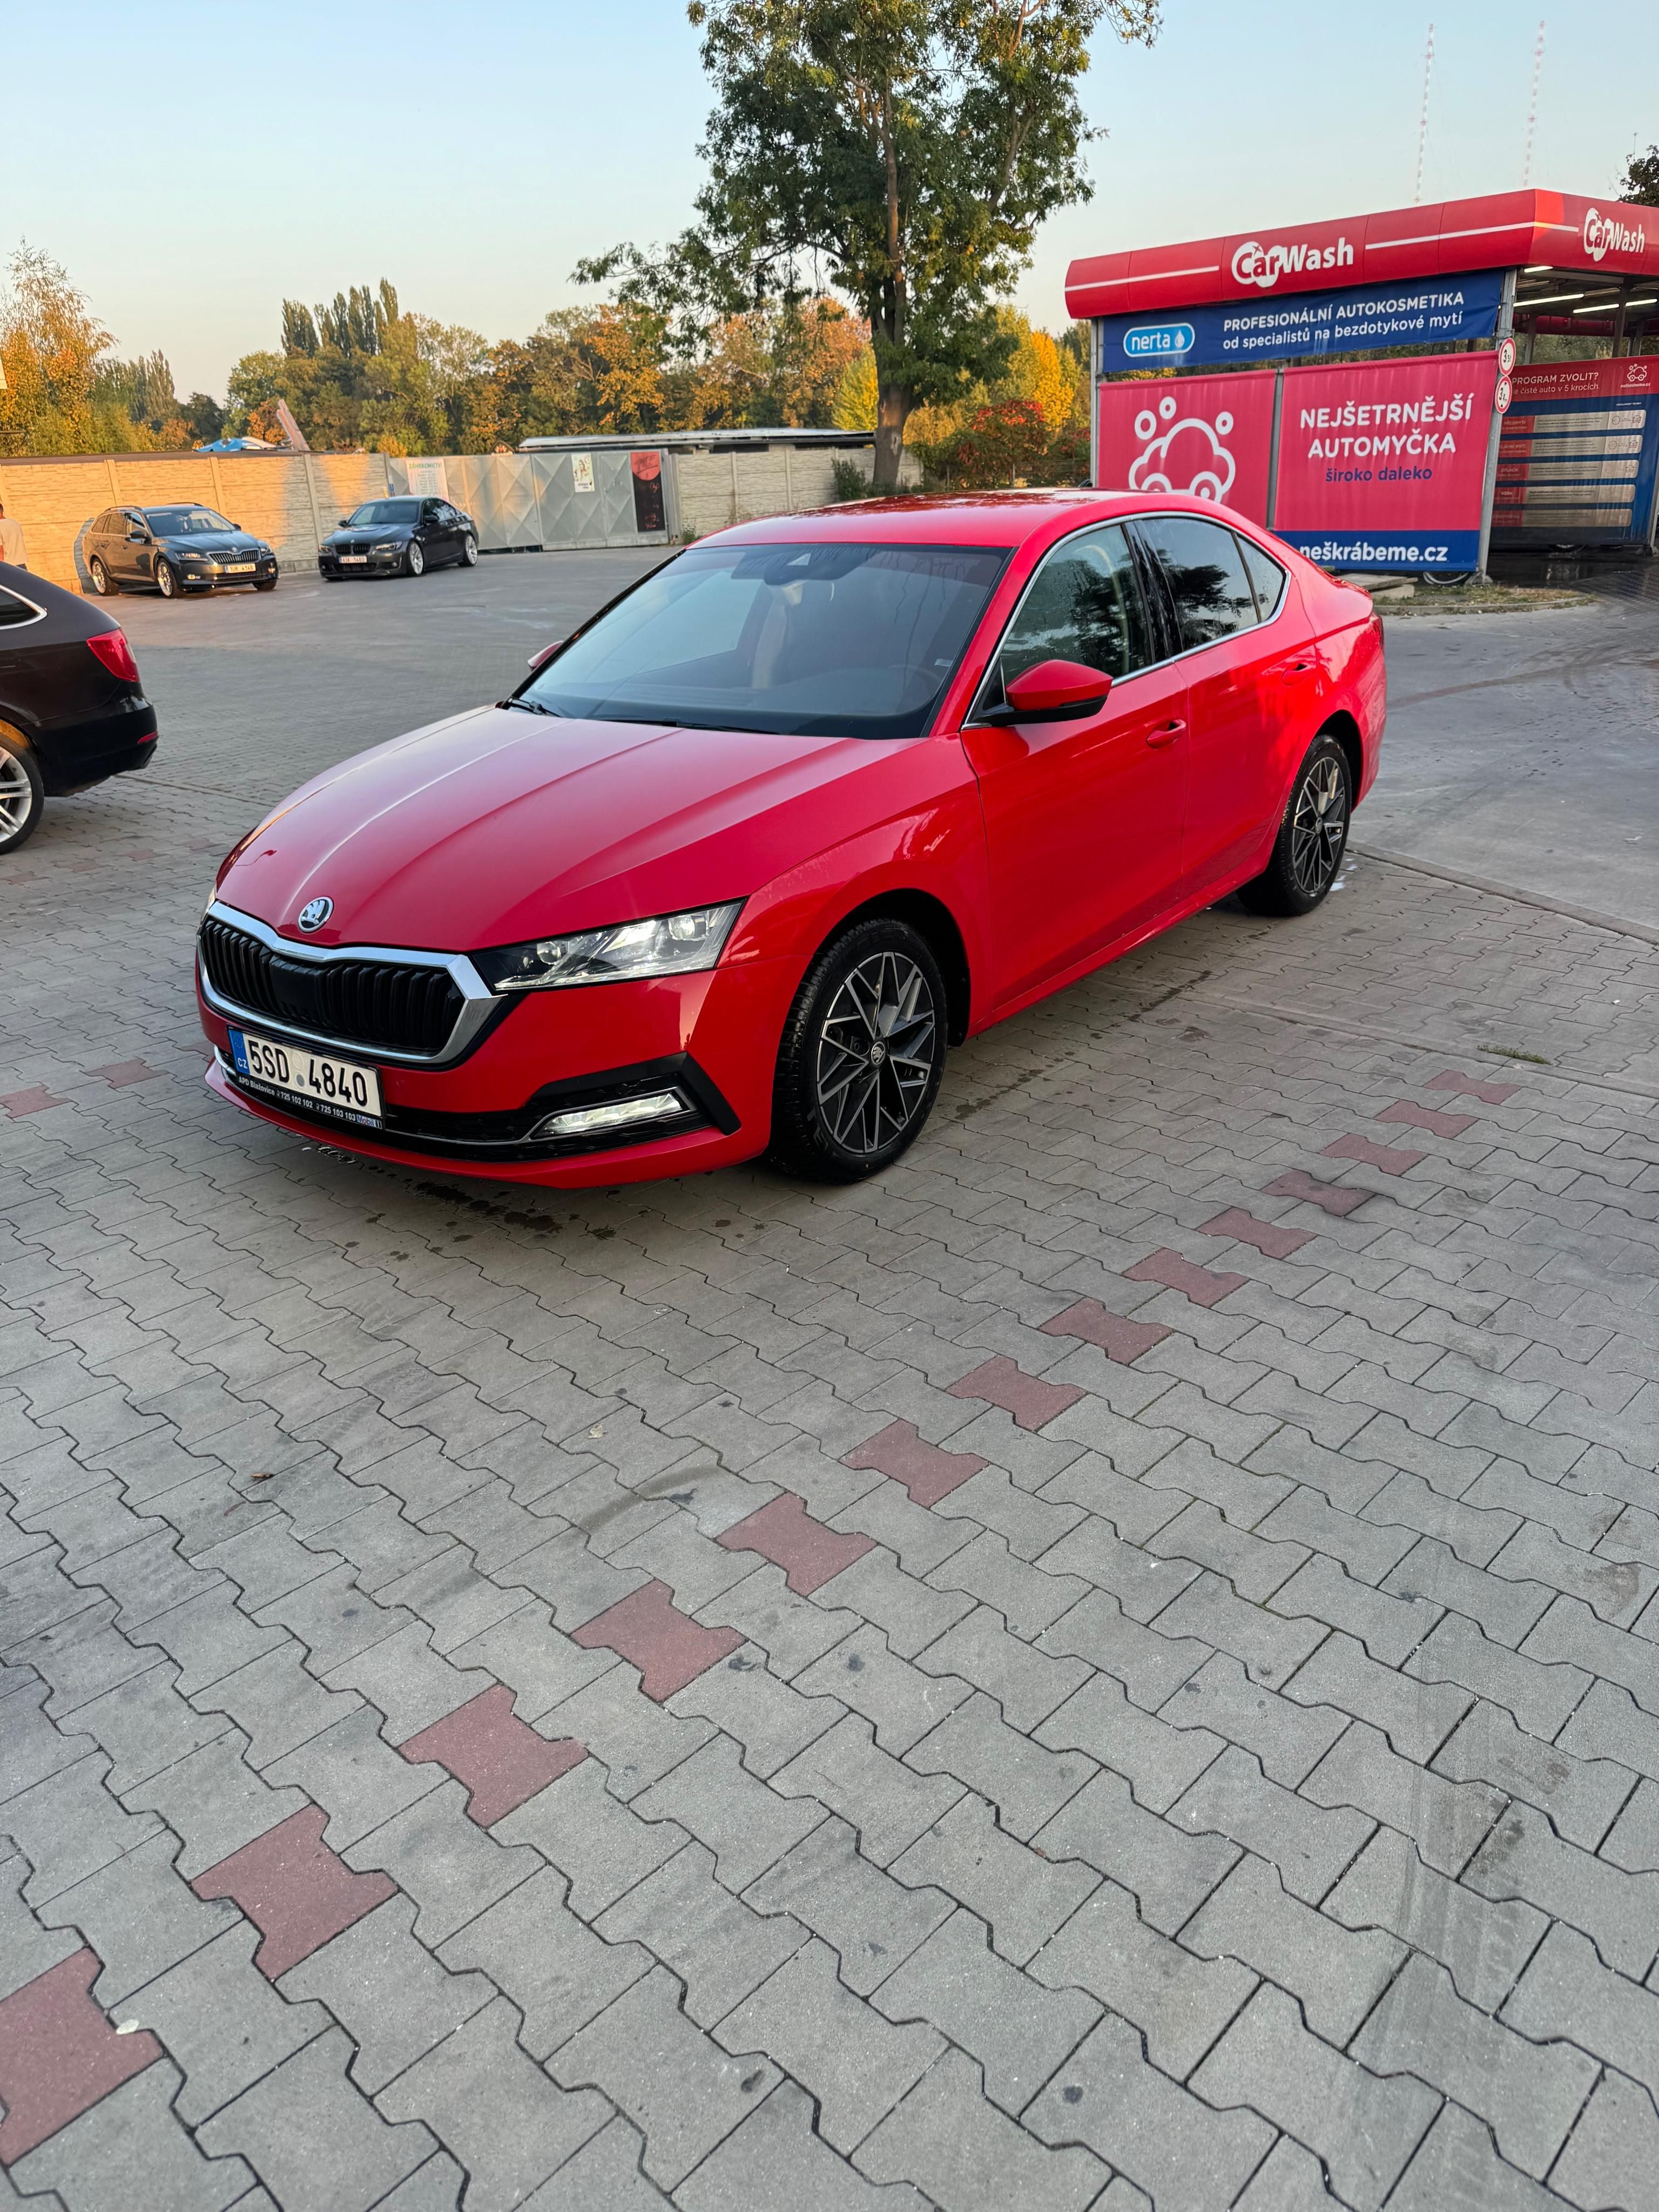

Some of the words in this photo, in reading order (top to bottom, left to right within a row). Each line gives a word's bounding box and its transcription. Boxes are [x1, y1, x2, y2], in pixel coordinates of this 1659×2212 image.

[1584, 207, 1645, 261] CarWash
[1232, 237, 1354, 287] CarWash
[1224, 304, 1333, 332] PROFESIONÁLNÍ
[1336, 292, 1464, 319] AUTOKOSMETIKA
[1131, 331, 1171, 350] nerta
[1223, 336, 1239, 349] od
[1243, 328, 1310, 349] specialistů
[1315, 329, 1330, 340] na
[1335, 315, 1425, 338] bezdotykové
[1429, 311, 1463, 328] mytí
[1512, 375, 1557, 385] PROGRAM
[1560, 372, 1599, 382] ZVOLIT?
[1520, 386, 1537, 394] čisté
[1571, 383, 1600, 391] krocích.
[1300, 393, 1474, 428] NEJŠETRNĚJŠÍ
[1308, 428, 1456, 458] AUTOMYČKA
[1326, 468, 1372, 482] široko
[1378, 466, 1433, 481] daleko
[1300, 541, 1448, 561] neškrábeme.cz
[238, 1057, 248, 1069] CZ
[248, 1040, 290, 1083] 5SD
[309, 1058, 368, 1107] 4840
[281, 1091, 291, 1101] 725
[292, 1095, 302, 1105] 102
[302, 1098, 313, 1108] 102
[320, 1104, 332, 1114] 725
[333, 1108, 344, 1117] 103
[345, 1111, 356, 1122] 103
